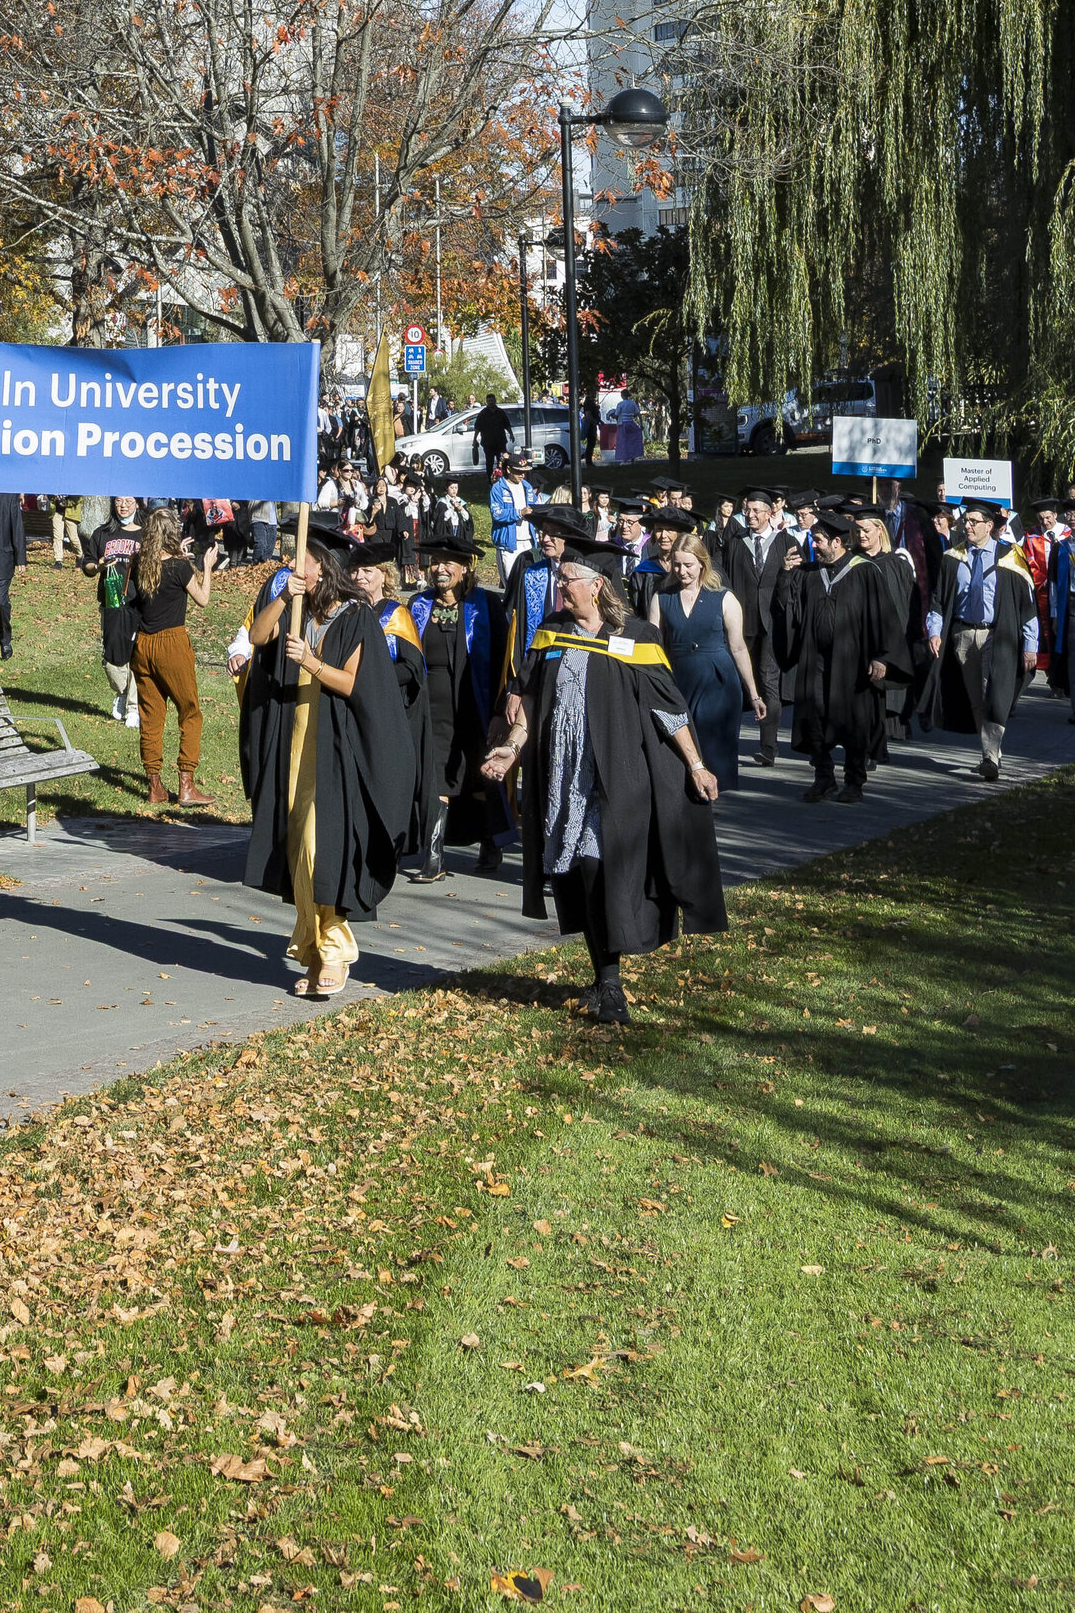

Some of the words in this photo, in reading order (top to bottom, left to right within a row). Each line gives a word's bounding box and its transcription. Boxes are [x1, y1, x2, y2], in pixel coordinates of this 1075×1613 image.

[410, 330, 420, 339] 10
[50, 372, 241, 418] University
[76, 422, 292, 461] Procession
[960, 467, 984, 475] Master
[958, 482, 997, 492] Computing
